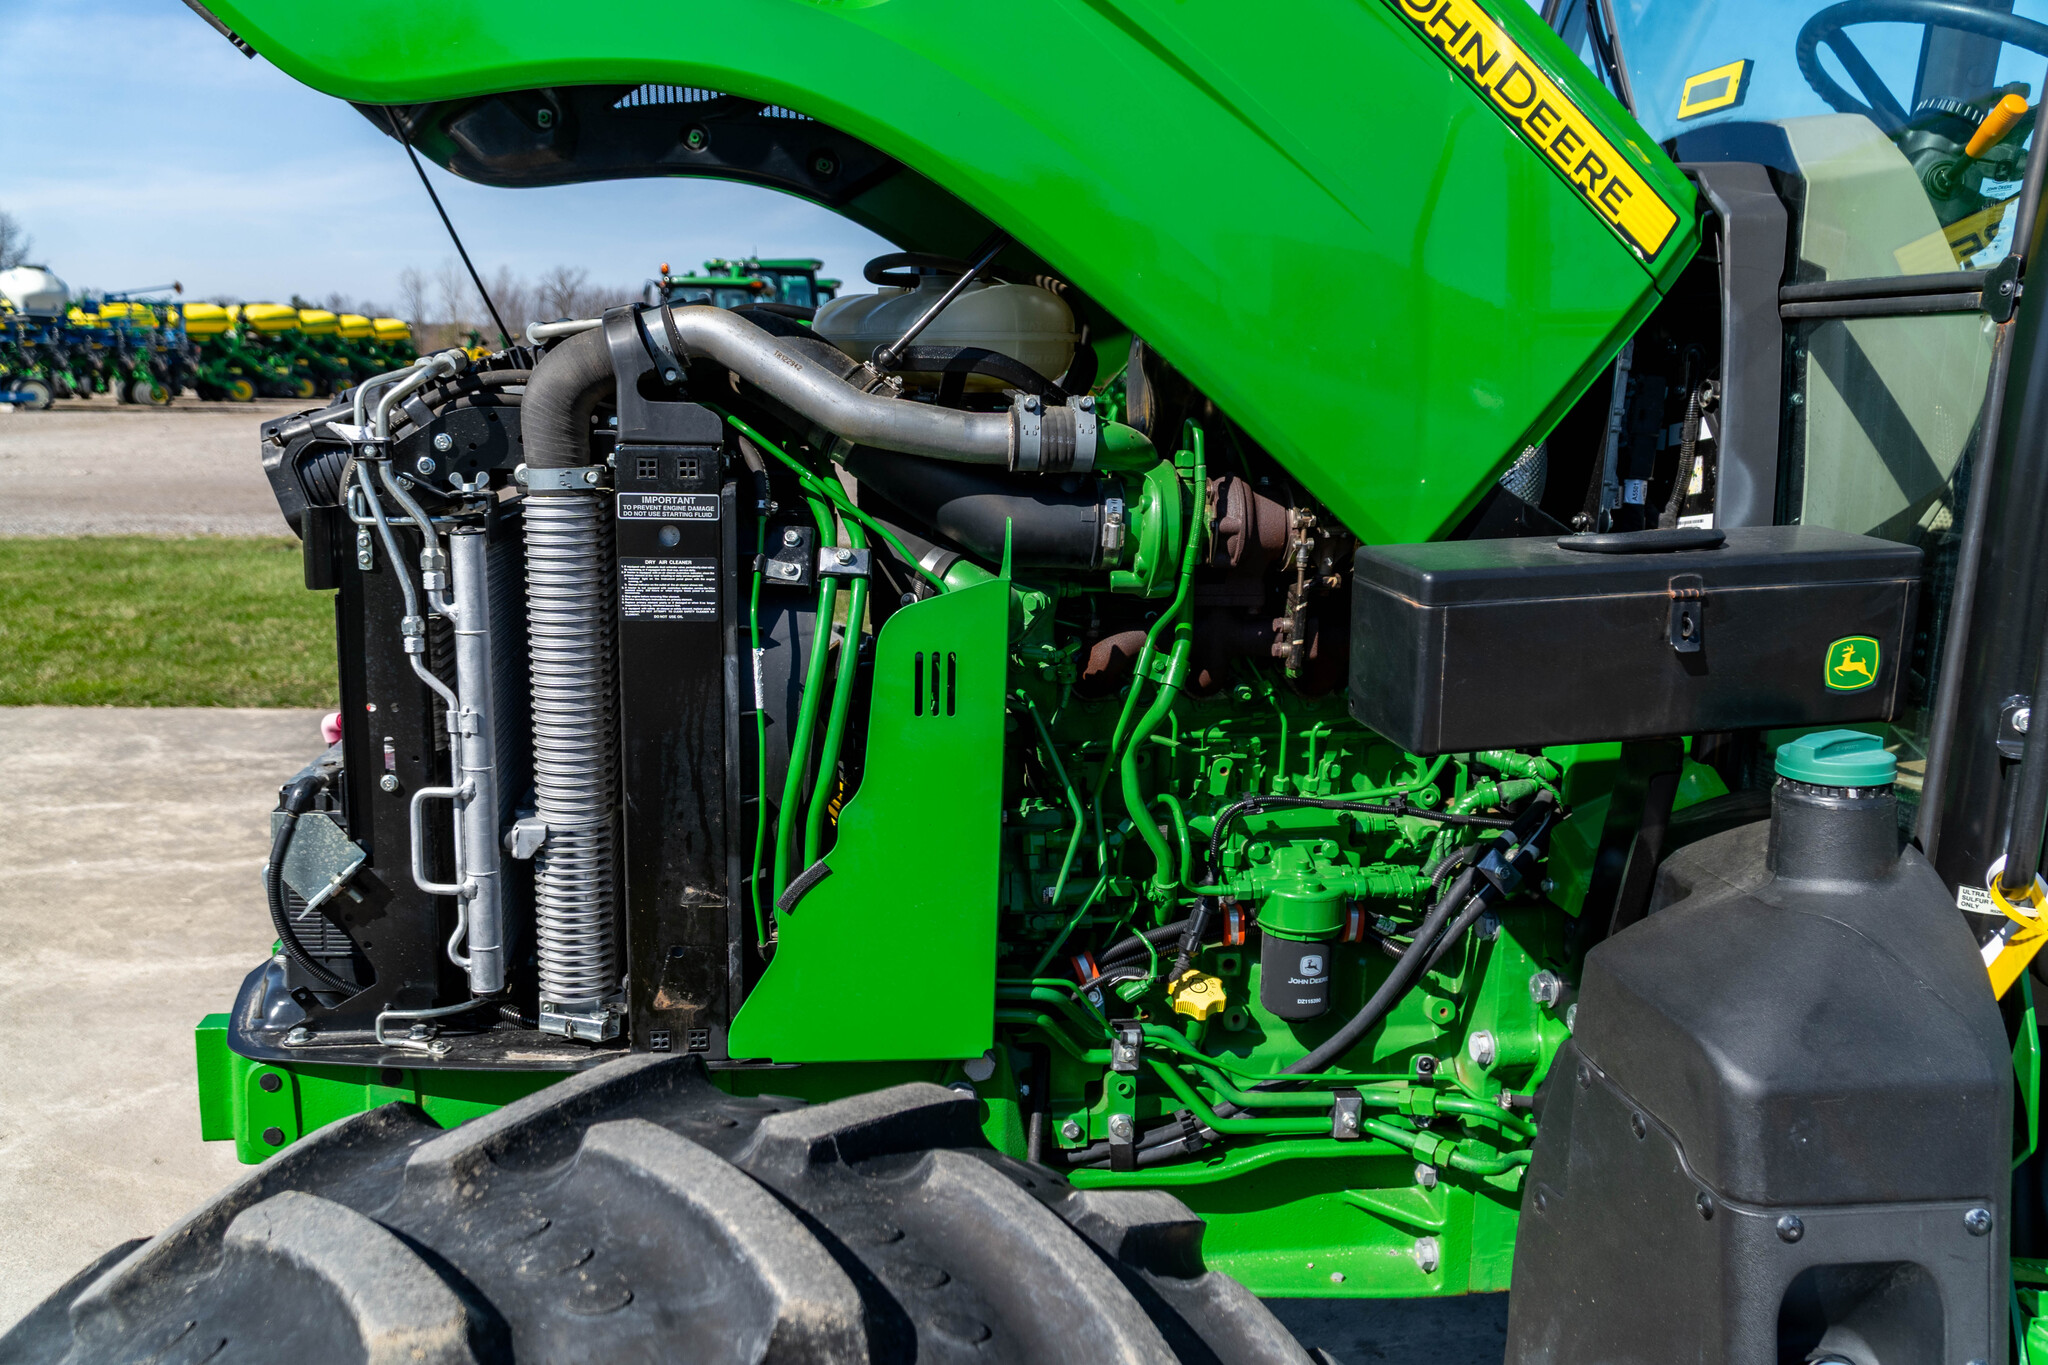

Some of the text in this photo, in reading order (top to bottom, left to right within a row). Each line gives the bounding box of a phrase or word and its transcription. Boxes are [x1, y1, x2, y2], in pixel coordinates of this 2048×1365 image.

[1493, 61, 1634, 217] DEERE
[641, 496, 696, 505] IMPORTANT
[1962, 888, 1985, 897] ULTRA
[1961, 895, 1989, 904] SULFUR
[1961, 901, 1979, 909] ONLY
